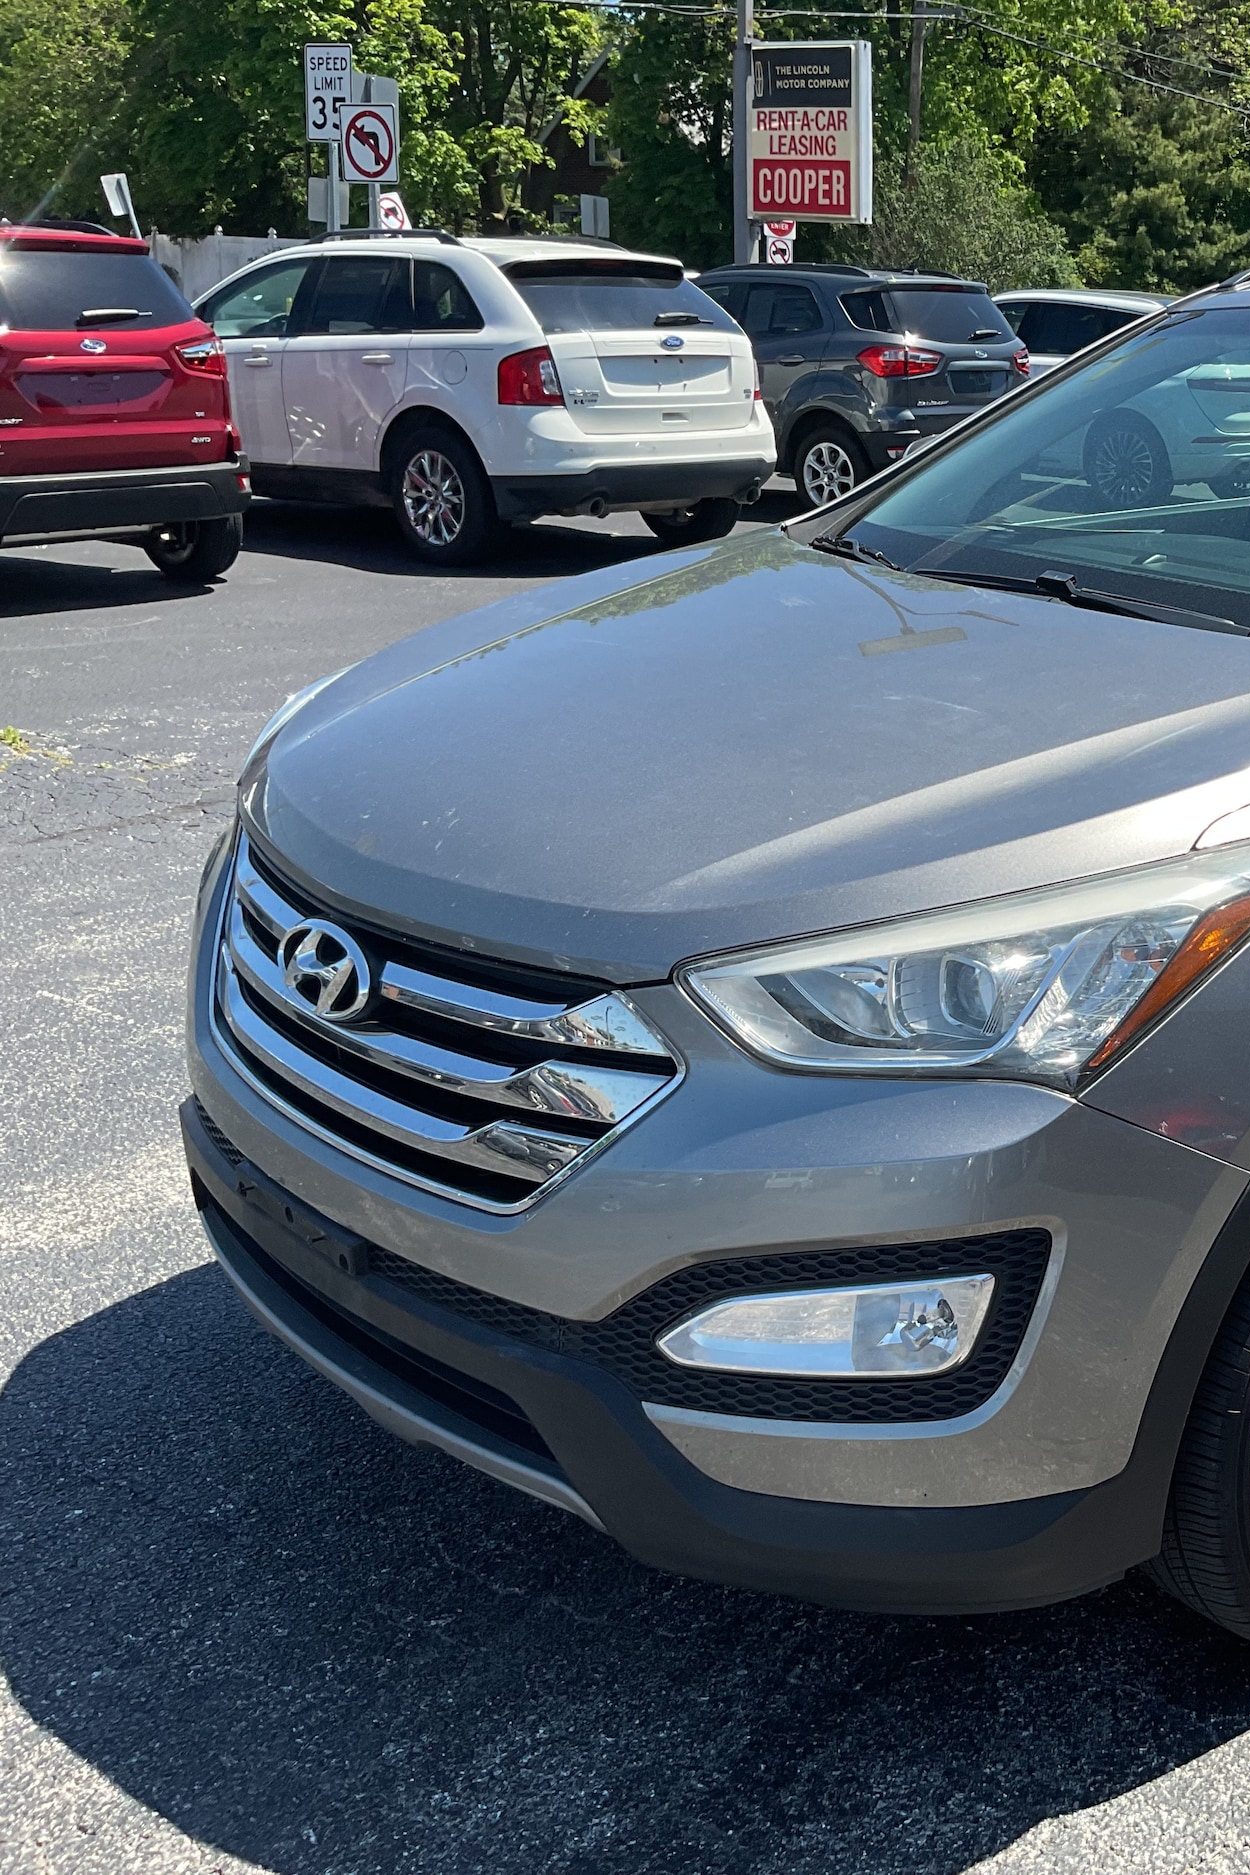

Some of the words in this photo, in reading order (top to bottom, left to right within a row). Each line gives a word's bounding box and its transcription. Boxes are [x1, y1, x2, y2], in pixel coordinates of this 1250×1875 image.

[310, 57, 348, 71] SPEED
[775, 66, 792, 75] THE
[793, 65, 830, 75] LINCOLN
[314, 77, 344, 91] LIMIT
[776, 80, 806, 89] MOTOR
[807, 79, 850, 89] COMPANY
[757, 110, 848, 132] RENT-A-CAR
[769, 134, 837, 156] LEASING
[758, 167, 845, 206] COOPER
